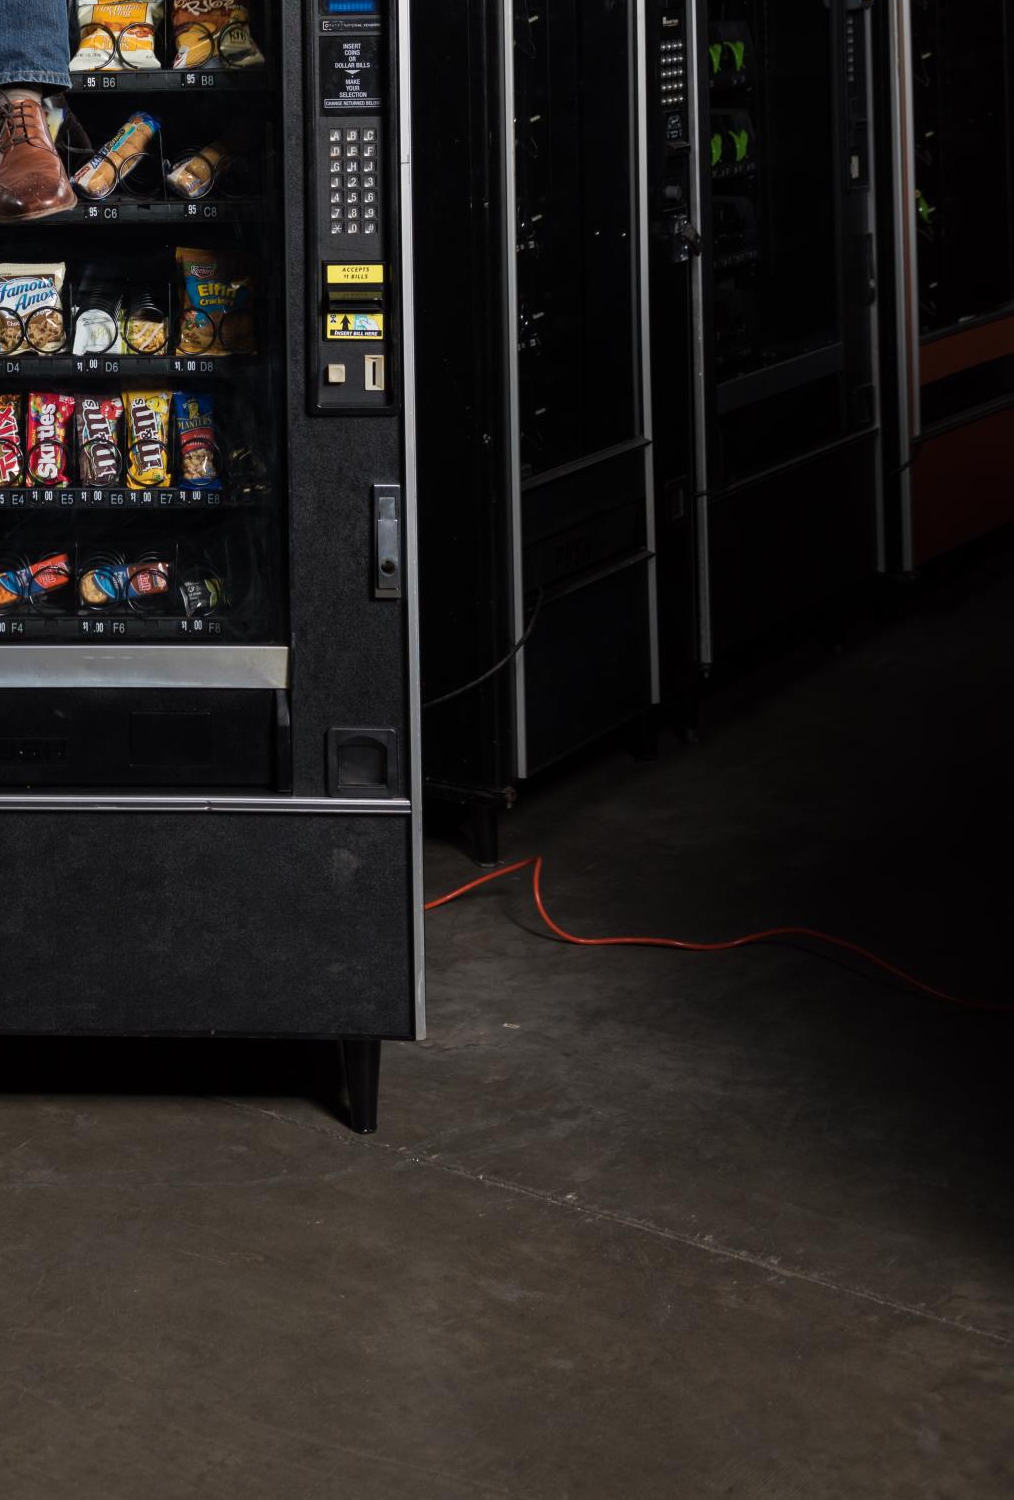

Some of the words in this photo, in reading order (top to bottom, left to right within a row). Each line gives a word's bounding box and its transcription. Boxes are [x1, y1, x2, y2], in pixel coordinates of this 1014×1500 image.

[83, 76, 96, 88] .95
[102, 77, 116, 88] B6
[181, 73, 196, 86] .95
[201, 75, 215, 86] B8
[333, 131, 340, 140] A
[350, 131, 357, 140] B
[367, 131, 374, 140] C
[333, 146, 340, 156] D
[350, 146, 357, 156] E
[367, 146, 374, 156] F
[333, 162, 340, 171] G
[350, 162, 357, 171] H
[367, 162, 374, 171] J
[333, 177, 340, 186] 1
[350, 177, 357, 186] 2
[367, 177, 374, 186] 3
[333, 192, 340, 202] 4
[350, 192, 357, 202] 5
[367, 192, 374, 202] 6
[85, 206, 98, 219] .95
[104, 208, 118, 219] C6
[185, 204, 197, 217] .95
[203, 206, 218, 218] C8
[333, 208, 340, 217] 7
[350, 208, 357, 217] 8
[367, 208, 374, 217] 9
[351, 223, 358, 233] 0
[197, 282, 237, 299] Elfin
[14, 289, 57, 316] Amos
[6, 362, 20, 373] D4
[77, 359, 98, 372] $1.00
[105, 362, 119, 373] D6
[174, 360, 196, 372] $1.00
[200, 362, 214, 373] D8
[36, 403, 59, 479] Skittles
[11, 495, 25, 505] E4
[32, 490, 53, 505] $1.00
[60, 494, 74, 505] E5
[81, 490, 103, 504] $1.00
[110, 493, 124, 504] E6
[130, 491, 152, 505] $1.00
[159, 494, 173, 504] E7
[179, 490, 202, 504] $1.00
[207, 494, 221, 505] E8
[11, 622, 24, 633] F4
[82, 621, 104, 633] $1.00
[113, 622, 126, 633] F6
[181, 619, 203, 633] $1.00
[208, 622, 221, 634] F8
